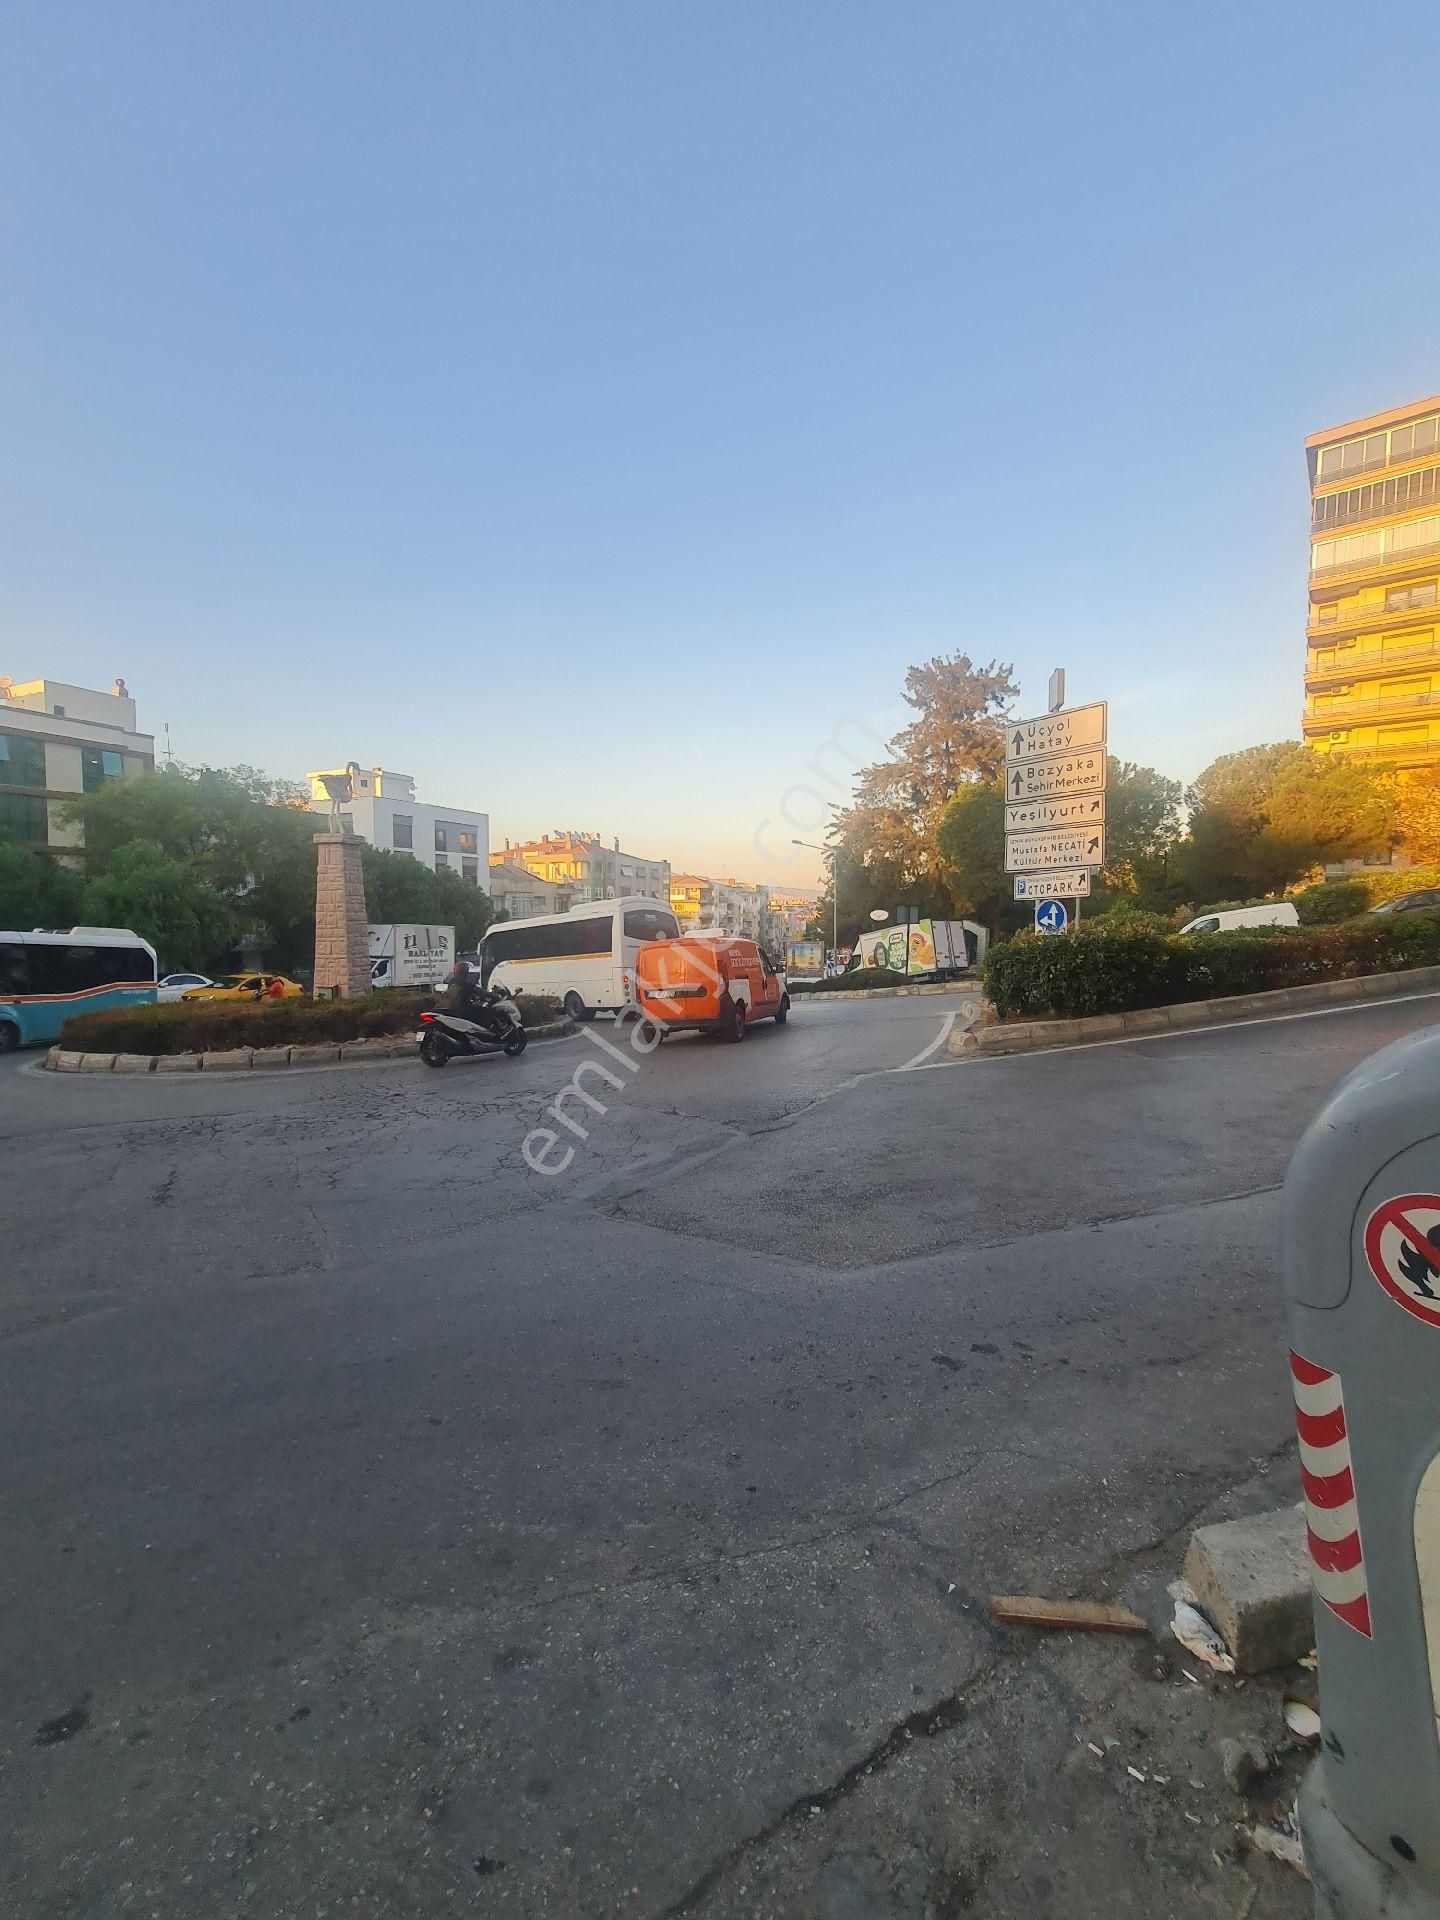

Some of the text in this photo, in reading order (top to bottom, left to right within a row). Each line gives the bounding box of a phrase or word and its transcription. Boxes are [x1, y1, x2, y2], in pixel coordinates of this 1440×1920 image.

[1028, 718, 1070, 737] Üçyol
[1028, 735, 1072, 751] Hatay
[1027, 759, 1094, 779] Bozyaka
[1027, 773, 1100, 793] Şehir Merkezi
[1010, 803, 1084, 821] Yeşilyurt
[1012, 838, 1086, 855] Mustafa NECATİ
[1044, 854, 1083, 864] Merkezi
[1028, 882, 1073, 896] OTOPARK
